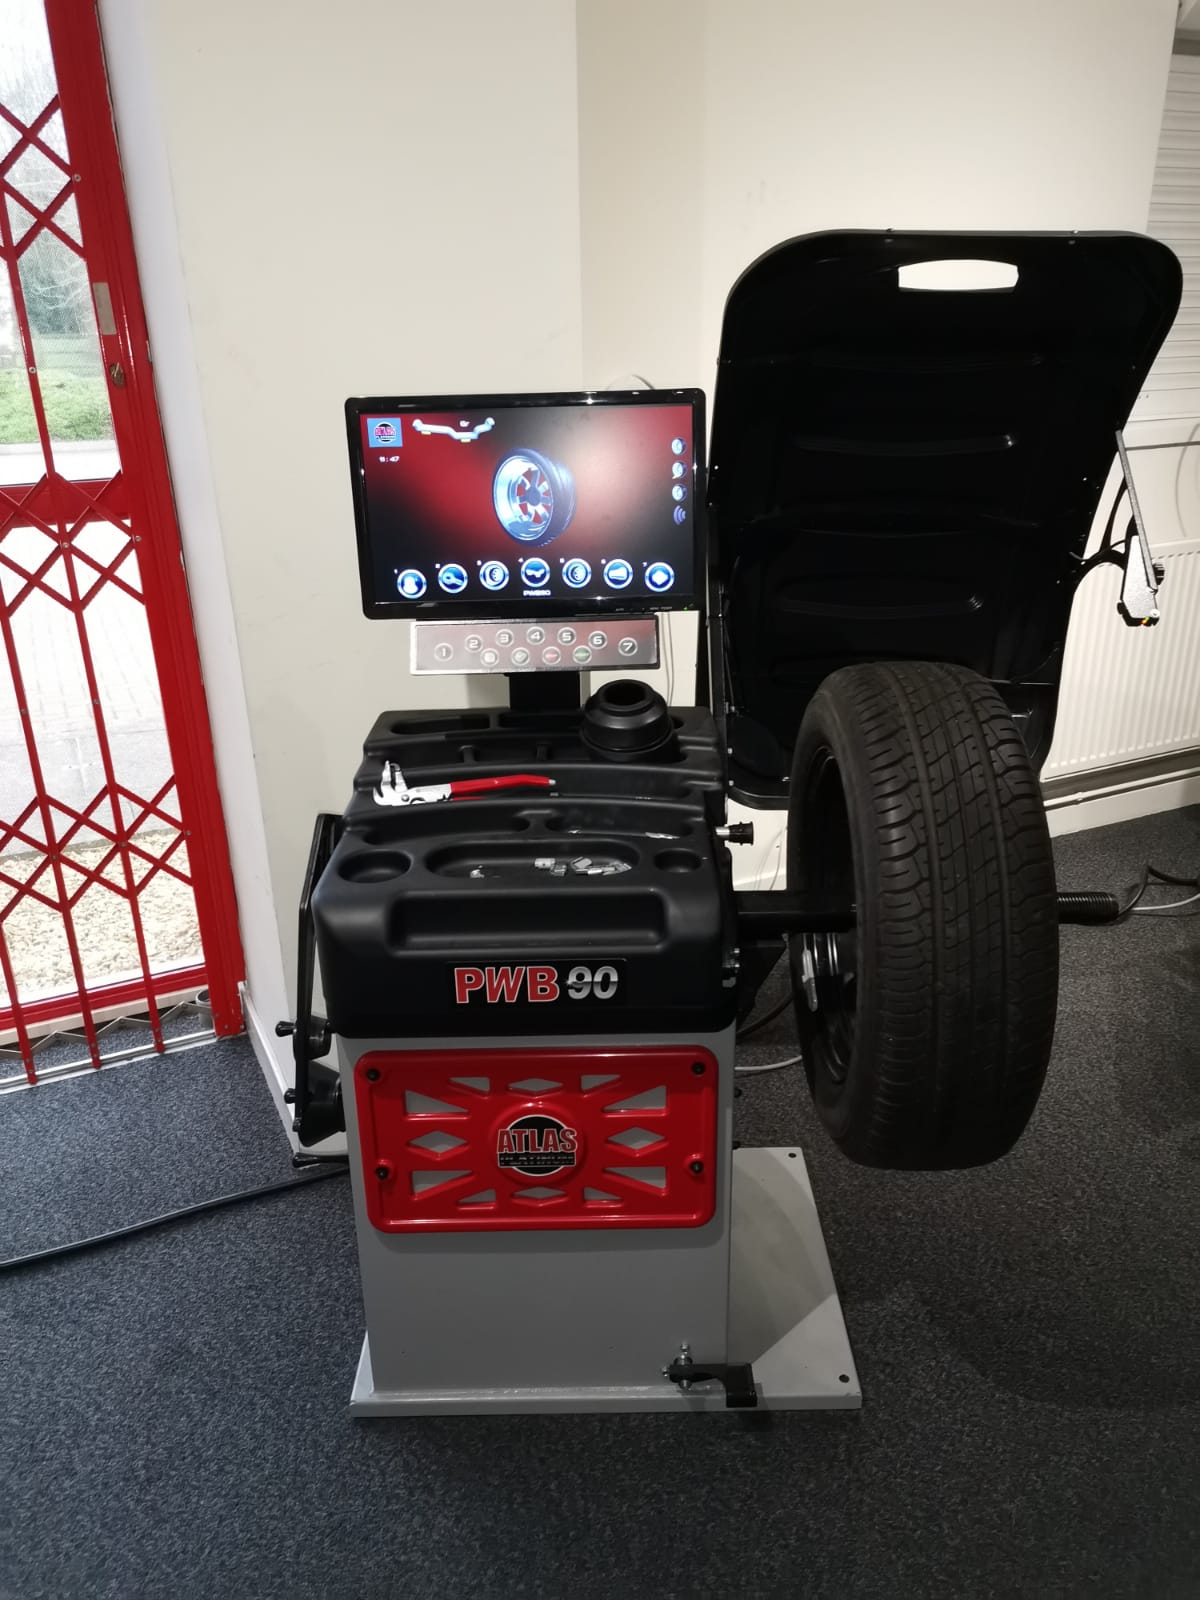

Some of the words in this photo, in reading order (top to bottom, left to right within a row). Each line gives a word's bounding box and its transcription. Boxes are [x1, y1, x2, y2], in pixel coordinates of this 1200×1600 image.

[500, 633, 509, 643] 3
[530, 631, 540, 640] 4
[562, 632, 571, 641] 5
[593, 636, 602, 645] 6
[469, 639, 478, 649] 2
[623, 642, 633, 652] 7
[442, 647, 447, 657] 1
[454, 965, 560, 1004] PWB
[567, 966, 619, 1000] 90
[497, 1128, 578, 1153] ATLAS
